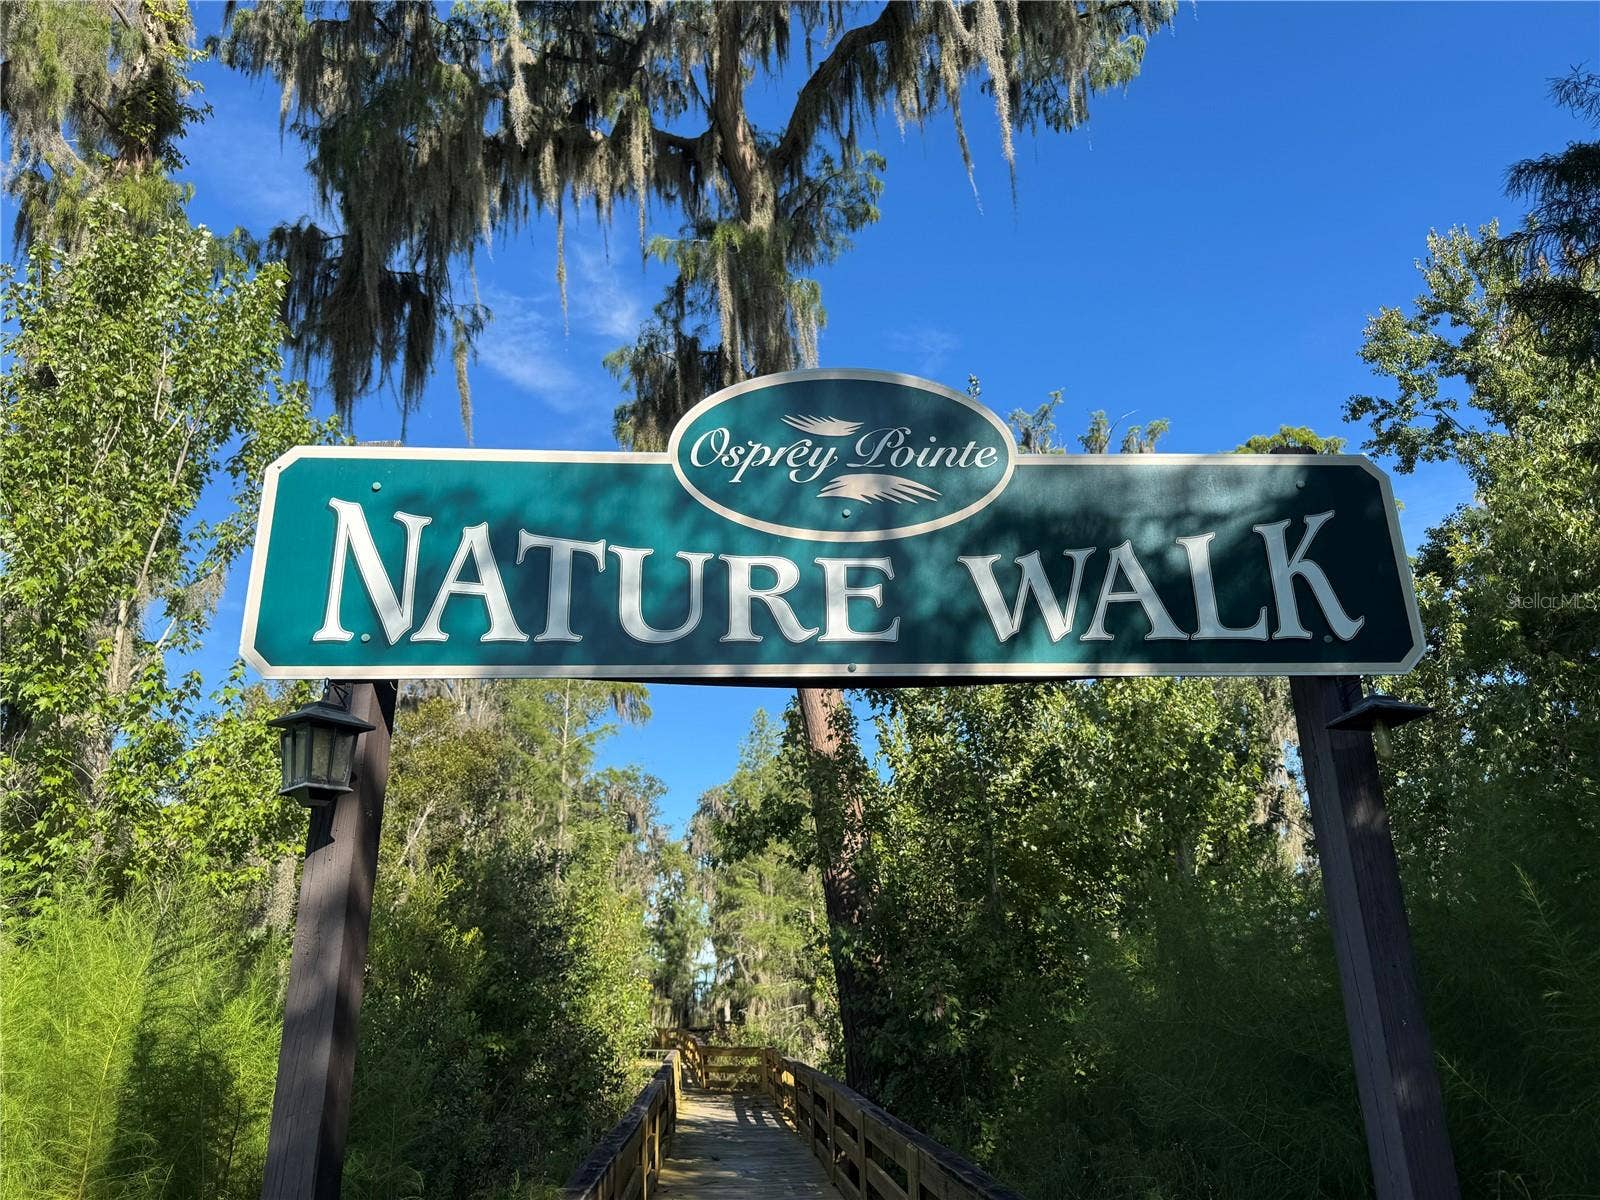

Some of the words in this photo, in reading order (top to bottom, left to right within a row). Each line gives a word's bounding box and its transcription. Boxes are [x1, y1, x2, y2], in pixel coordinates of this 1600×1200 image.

[690, 427, 838, 483] Osprey
[846, 427, 998, 468] Pointe
[312, 497, 900, 646] NATURE
[957, 509, 1365, 643] WALK
